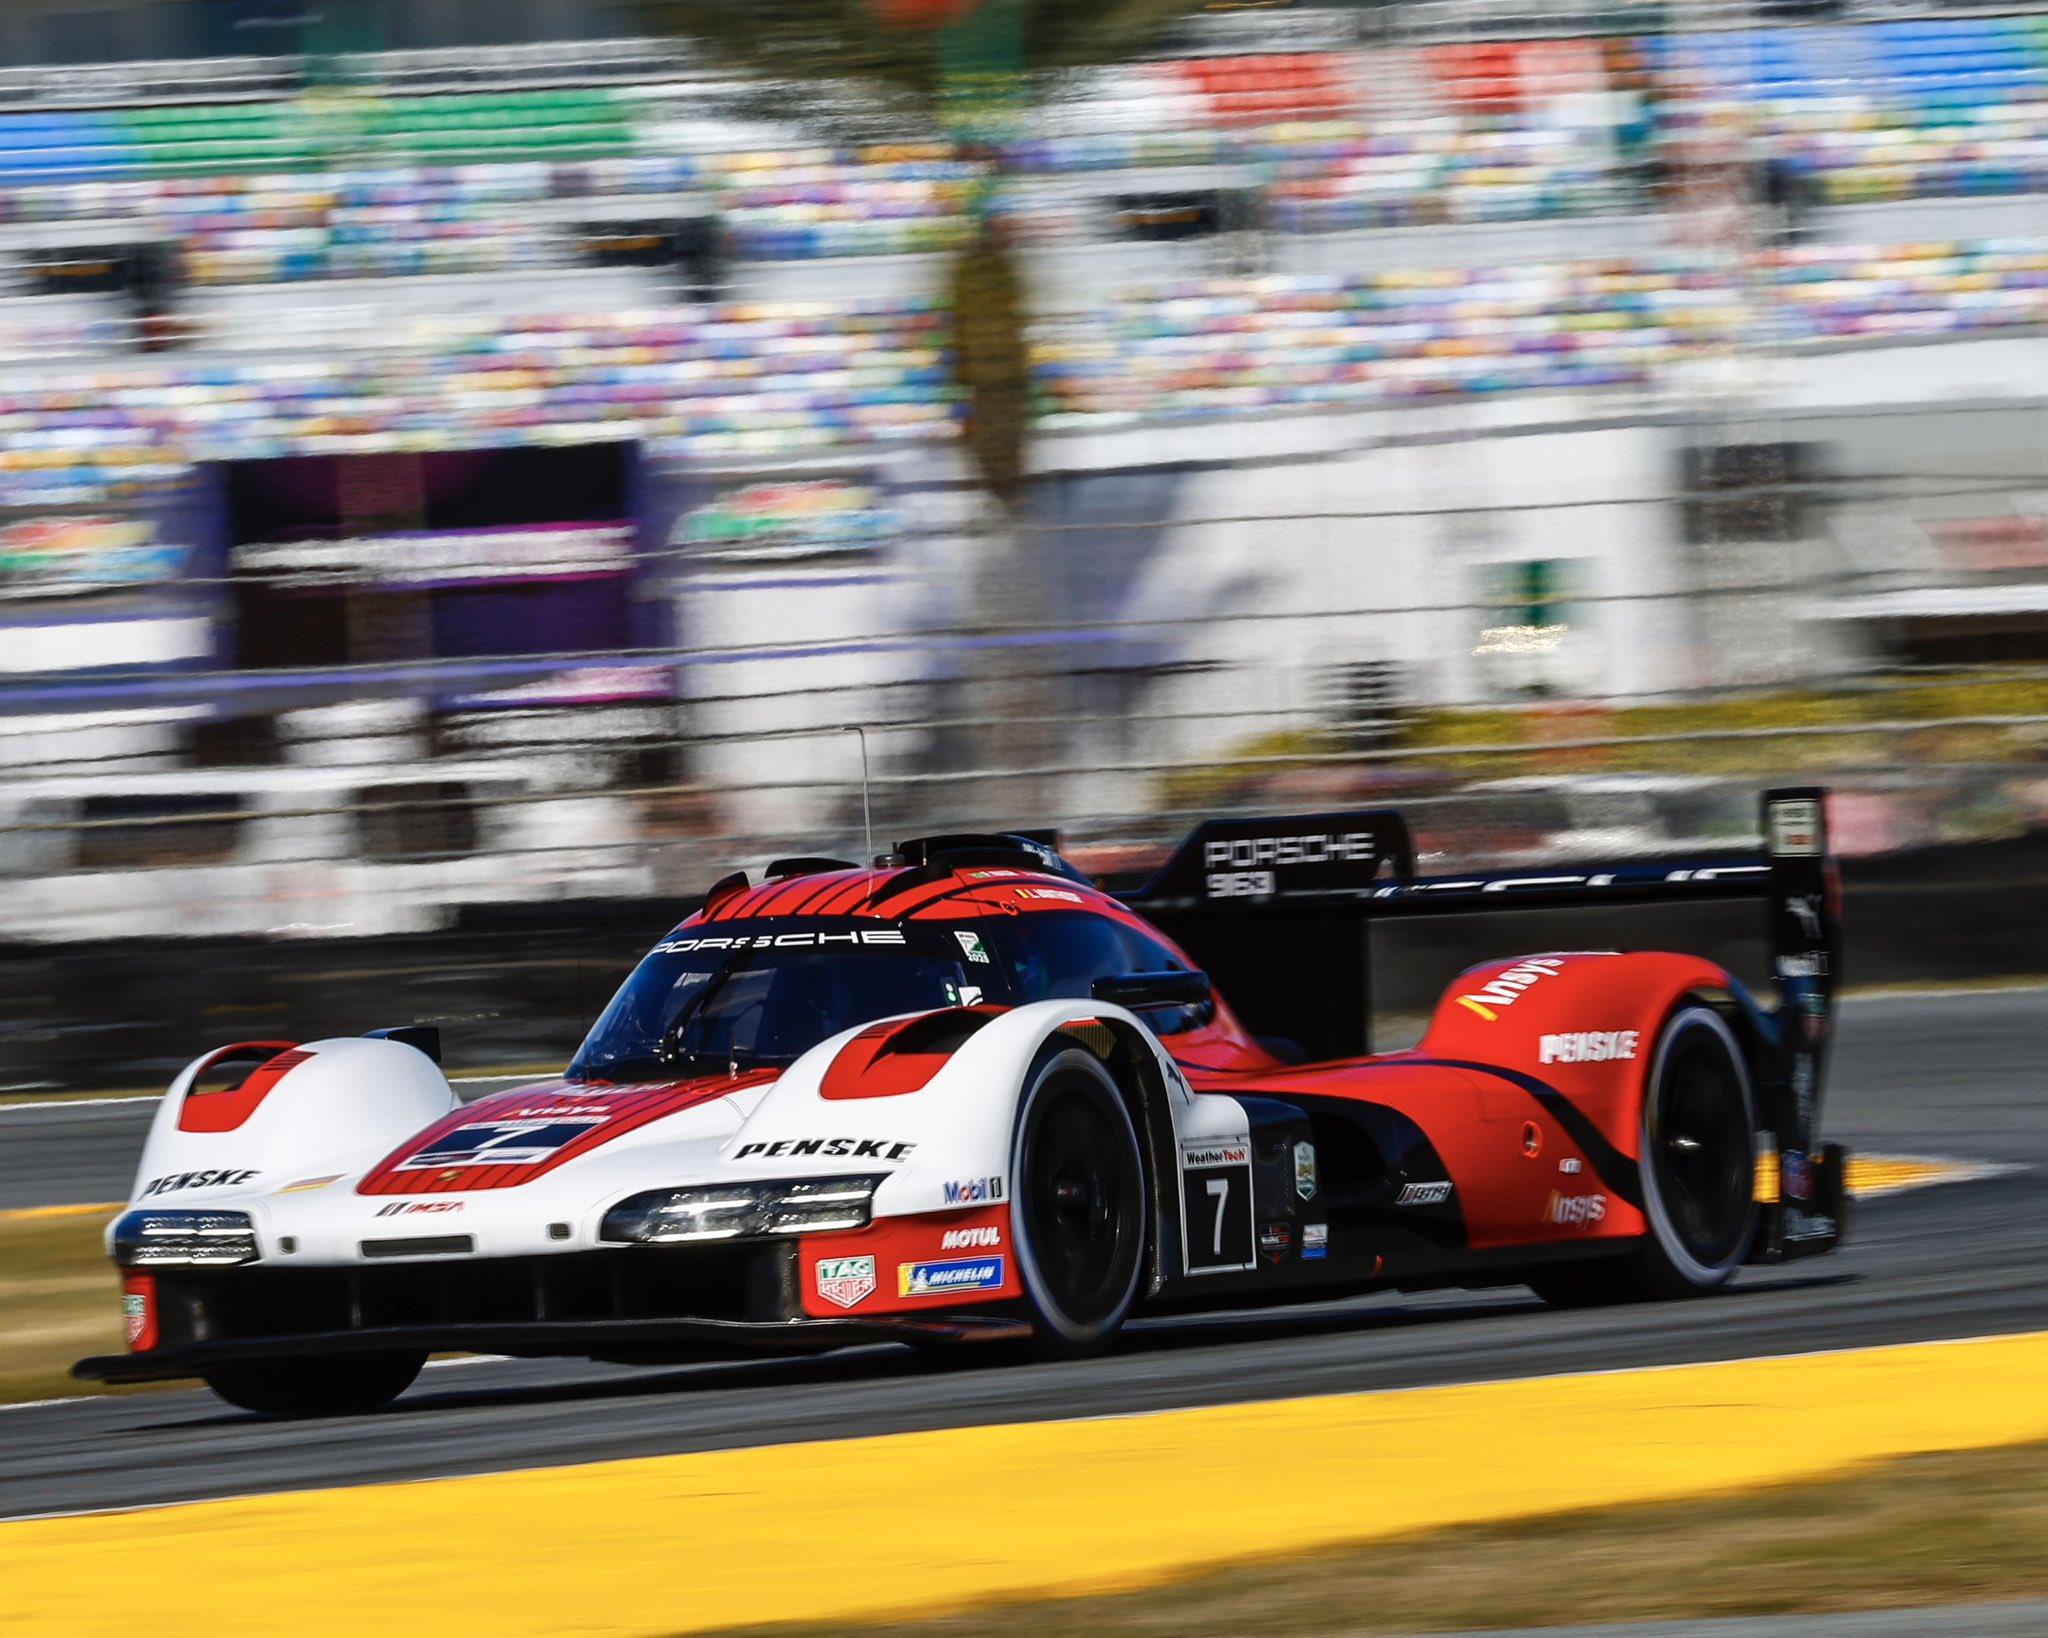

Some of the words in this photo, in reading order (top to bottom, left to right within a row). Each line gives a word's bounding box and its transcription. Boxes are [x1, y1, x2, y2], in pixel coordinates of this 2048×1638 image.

[1204, 832, 1376, 868] PORSCHE
[647, 929, 907, 957] PORSCHE
[1538, 1030, 1640, 1065] PENSKE
[732, 1138, 918, 1163] PENSKE
[1186, 1149, 1245, 1165] WeatherTech
[138, 1169, 262, 1201] PENSKE
[943, 1177, 987, 1204] Mobil
[991, 1177, 1002, 1198] 1
[1206, 1178, 1229, 1255] 7
[941, 1227, 1000, 1250] MOTUL
[823, 1260, 871, 1279] TAG
[929, 1266, 995, 1285] MICHELIN
